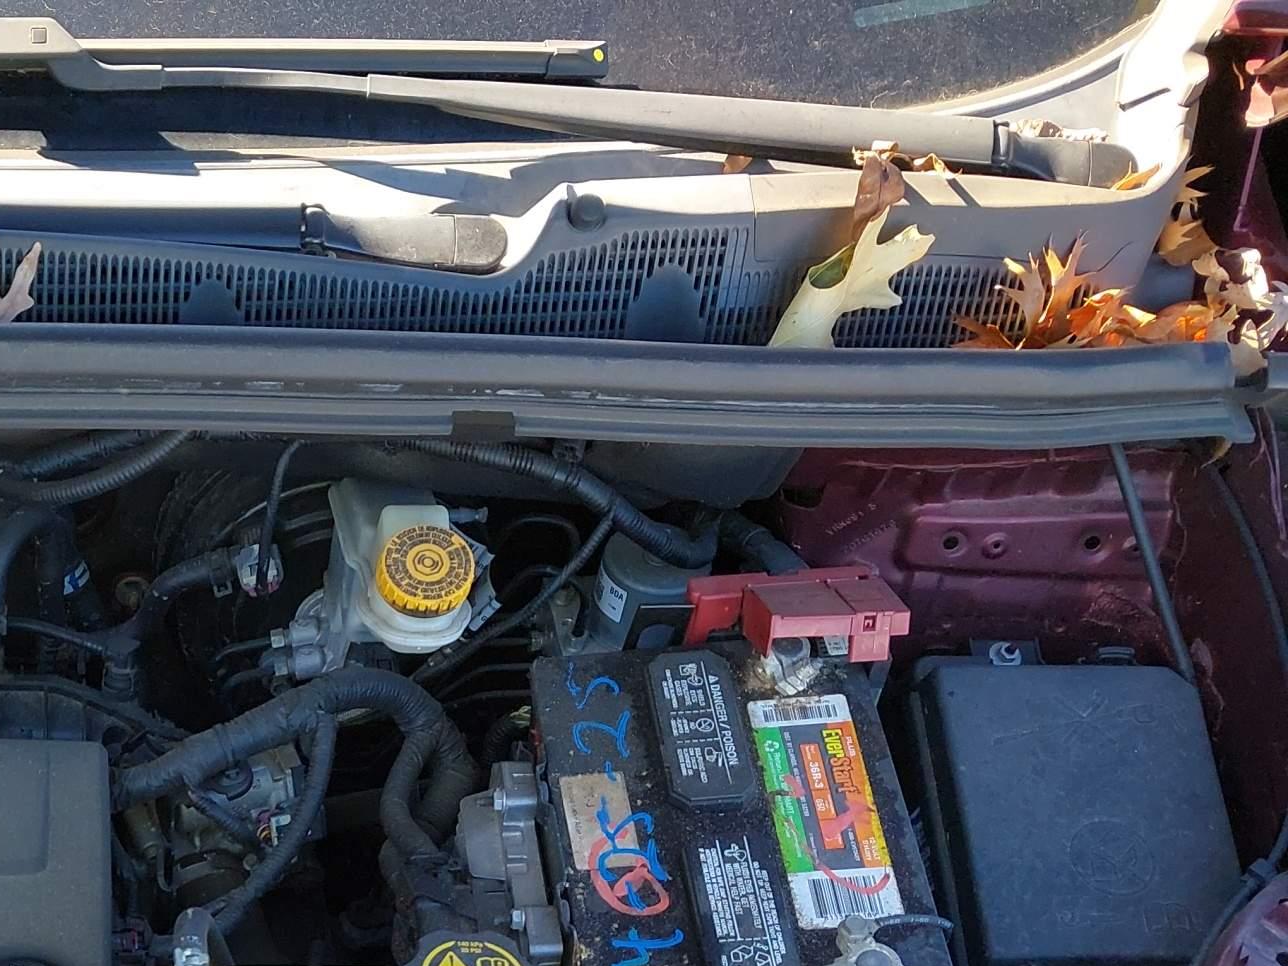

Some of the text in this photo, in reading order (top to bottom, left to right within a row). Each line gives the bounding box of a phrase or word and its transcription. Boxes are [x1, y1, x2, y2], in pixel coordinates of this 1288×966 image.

[709, 684, 729, 721] DANGER
[720, 730, 739, 765] POISON
[844, 736, 856, 757] PLUS
[808, 761, 824, 788] 36R-3
[821, 728, 858, 793] EverStart
